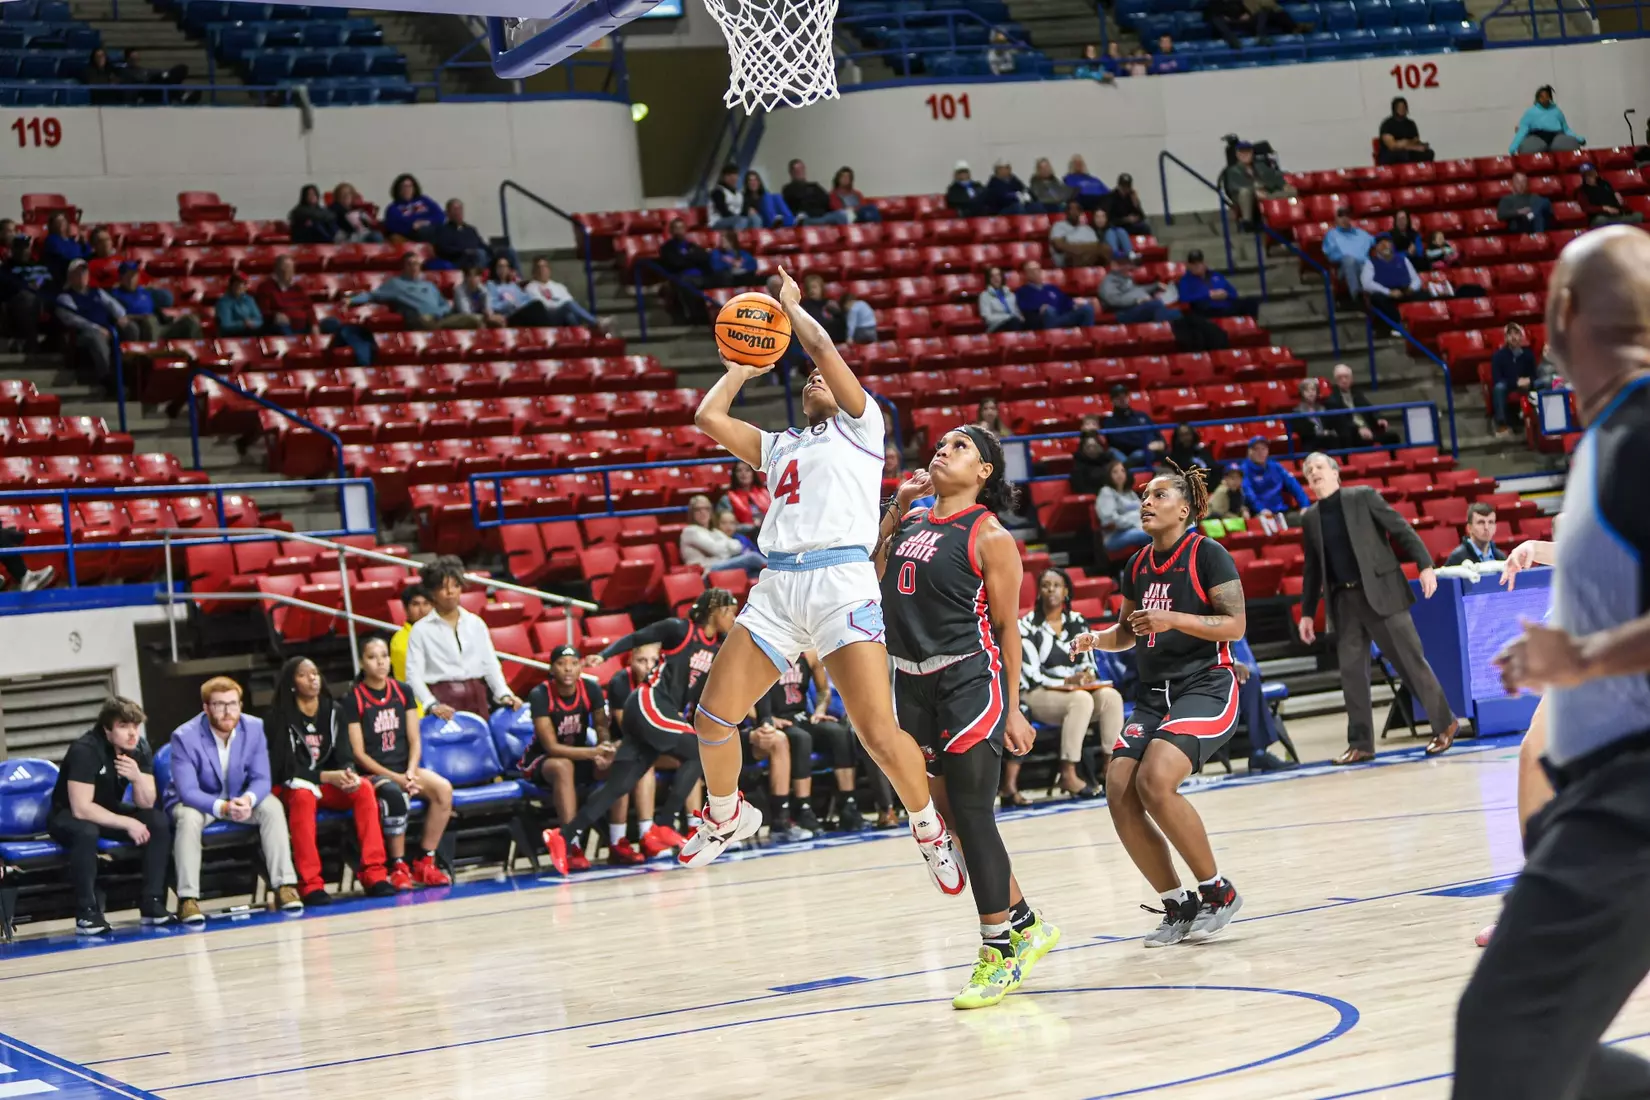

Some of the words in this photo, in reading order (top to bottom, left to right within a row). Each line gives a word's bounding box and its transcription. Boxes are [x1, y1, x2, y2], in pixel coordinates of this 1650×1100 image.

[1390, 62, 1440, 90] 102
[926, 92, 972, 120] 101
[11, 117, 62, 148] 119
[736, 308, 775, 324] NCAA
[727, 328, 776, 349] Wilson
[774, 458, 801, 505] 4
[895, 541, 939, 563] STATE
[907, 529, 944, 547] JAX
[897, 560, 917, 595] 0
